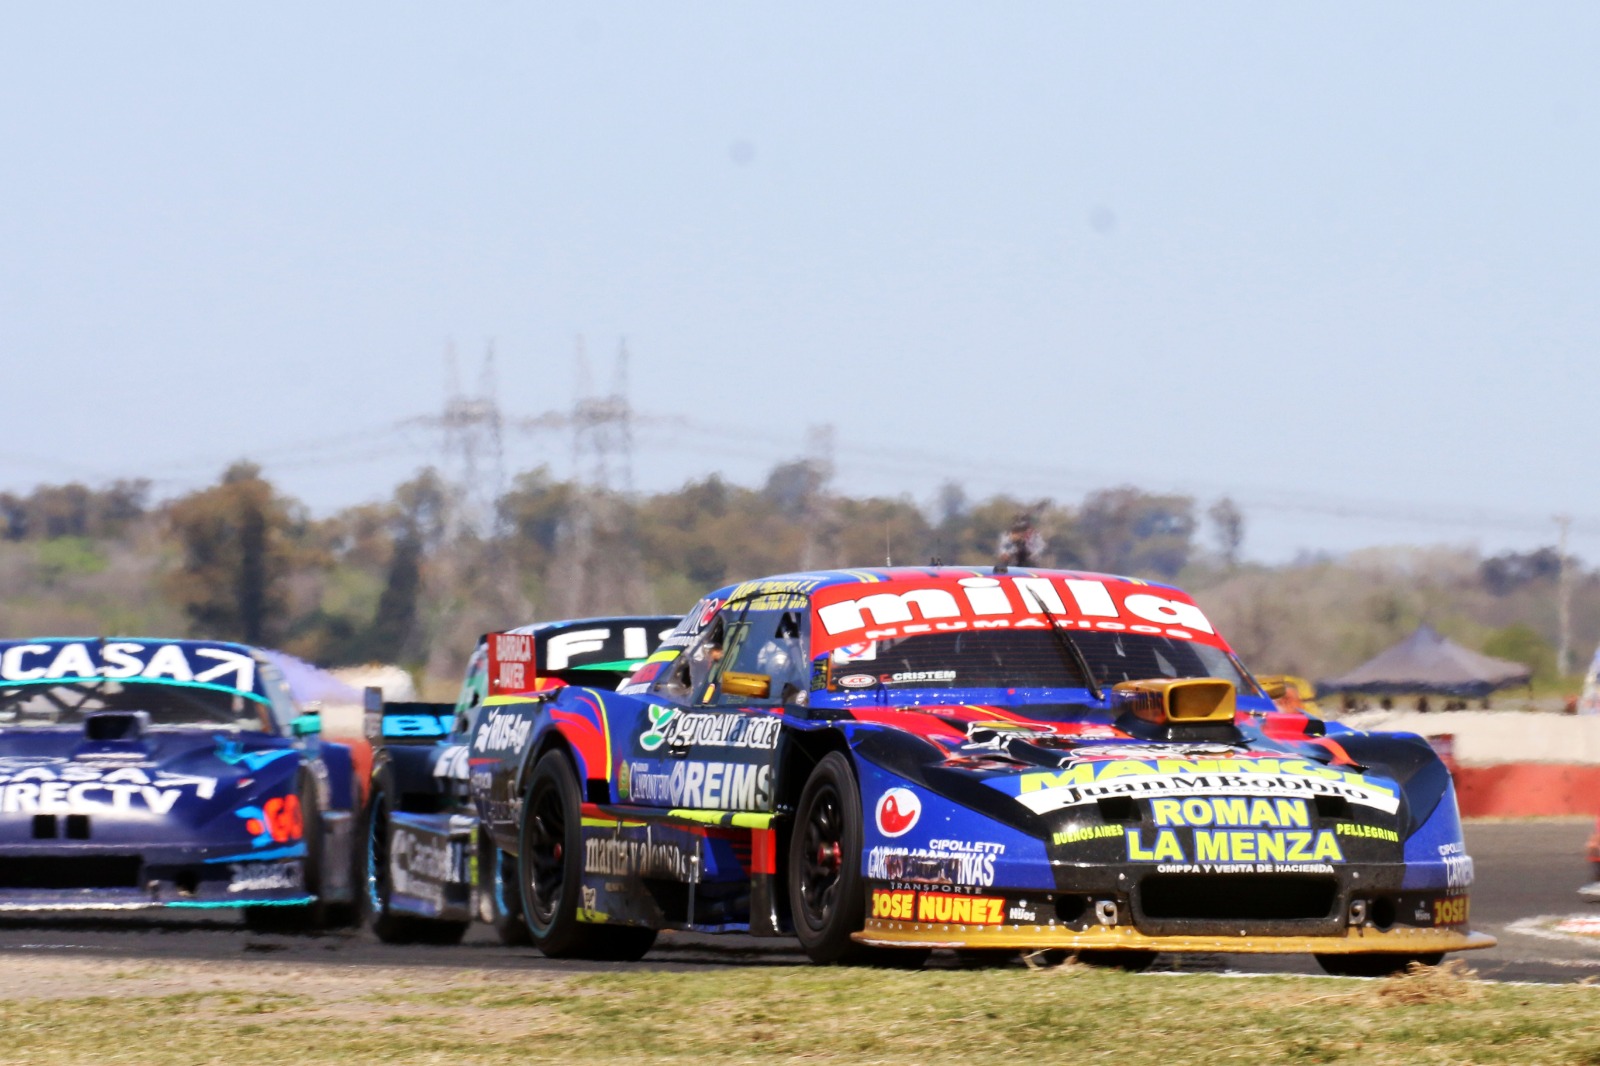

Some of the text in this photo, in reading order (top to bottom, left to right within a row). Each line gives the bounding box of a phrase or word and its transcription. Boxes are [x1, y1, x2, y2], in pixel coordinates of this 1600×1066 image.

[818, 577, 1215, 636] milla
[1, 642, 196, 682] CASA
[892, 670, 957, 682] CRISTEM
[0, 766, 151, 786] ASA
[683, 761, 776, 812] REIMS
[1152, 798, 1310, 828] ROMAN
[1053, 823, 1124, 846] BUENOS AIRES
[1336, 822, 1399, 843] PELLEGRINI
[929, 838, 1006, 855] CIPOLLETTI
[1127, 830, 1343, 862] LA MENZA
[1213, 863, 1253, 873] VENTA
[1256, 863, 1273, 873] DE
[1275, 863, 1335, 873] HACIENDA
[890, 881, 983, 895] TRANSPORTE
[871, 892, 1005, 924] JOSE NUÑEZ
